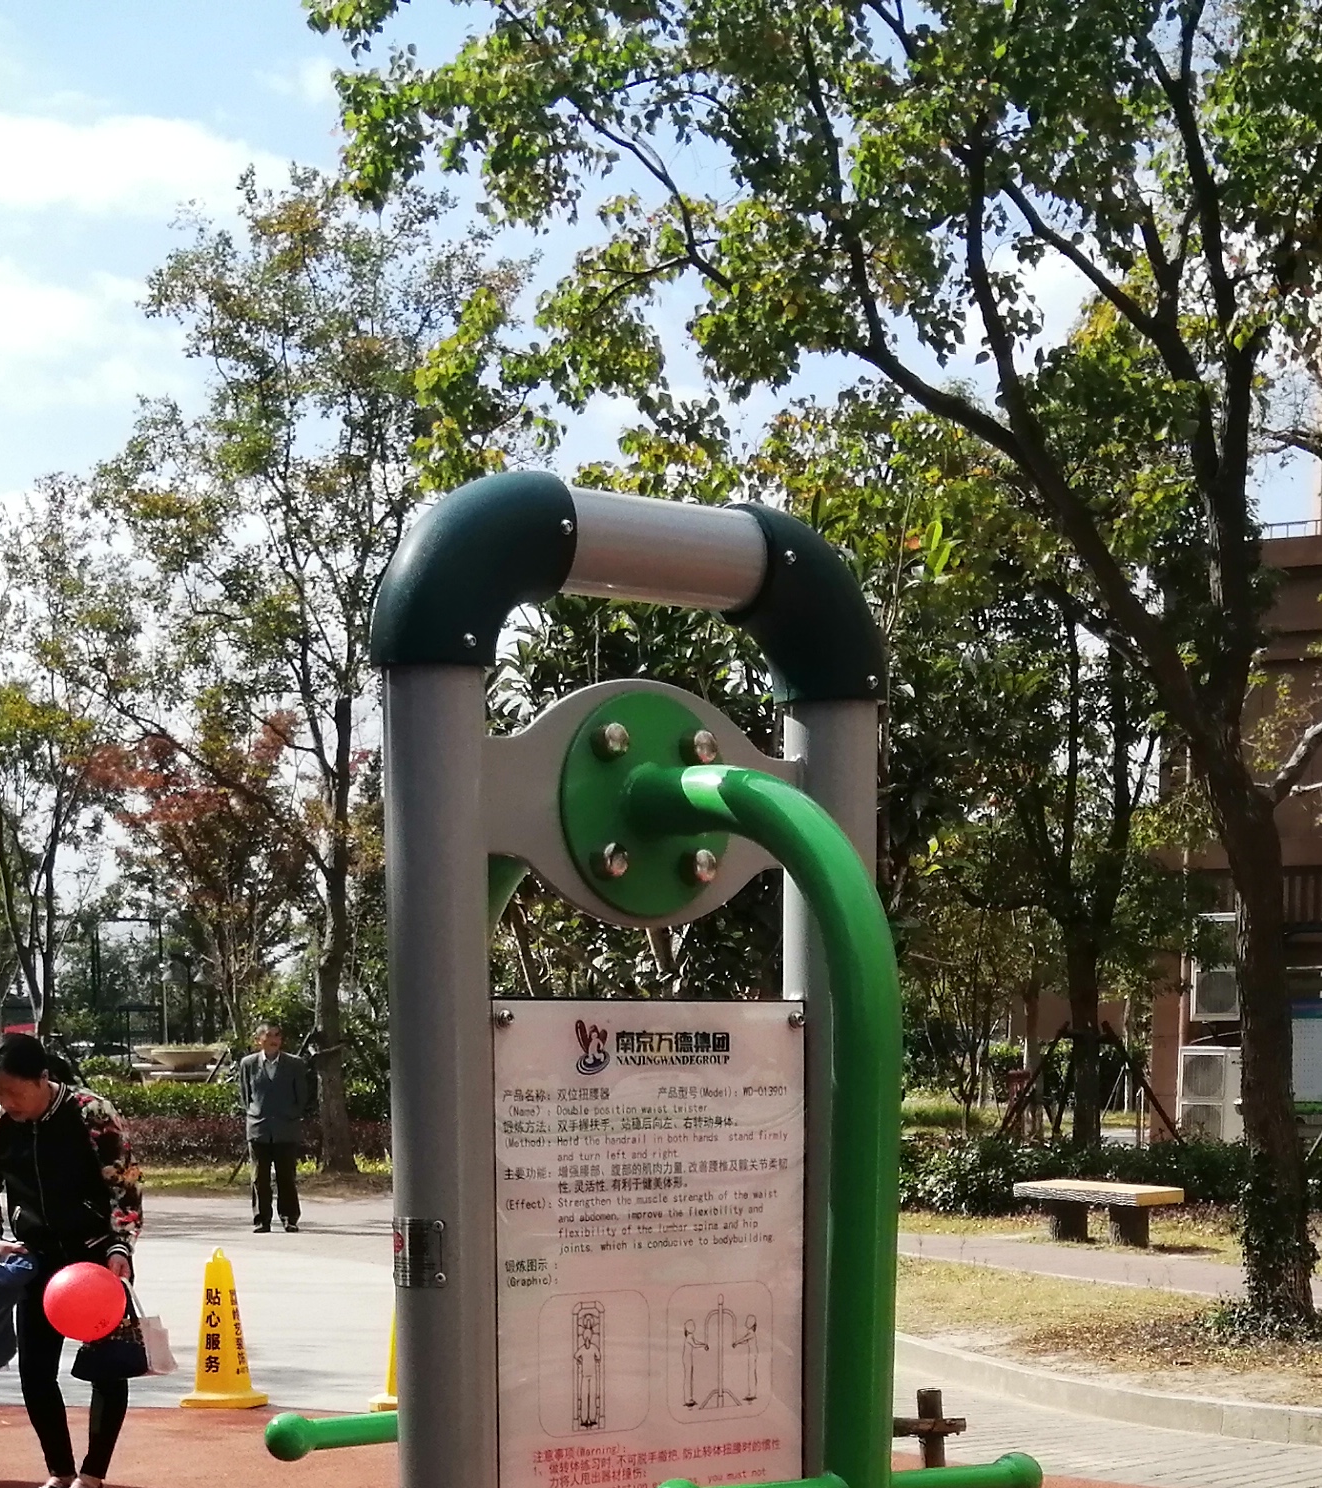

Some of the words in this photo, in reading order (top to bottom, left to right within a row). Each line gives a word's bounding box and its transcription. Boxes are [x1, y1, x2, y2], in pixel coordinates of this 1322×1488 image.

[616, 1030, 730, 1053] 南京万德集团
[616, 1055, 730, 1065] NANJINGWANDEGROUP
[556, 1105, 589, 1115] Double
[594, 1104, 637, 1118] position
[641, 1103, 667, 1114] waist
[673, 1103, 708, 1113] twister
[557, 1136, 579, 1146] Hold
[584, 1135, 600, 1146] the
[605, 1134, 646, 1145] handrail
[653, 1133, 663, 1143] in
[667, 1132, 689, 1143] both
[728, 1131, 754, 1141] stand
[758, 1129, 789, 1144] firmly
[557, 1152, 574, 1162] and
[579, 1152, 600, 1161] turn
[606, 1151, 626, 1160] left
[631, 1149, 648, 1159] and
[505, 1198, 552, 1211] (Effect):
[558, 1196, 611, 1209] Strengthen
[616, 1195, 632, 1205] the
[636, 1194, 668, 1204] muscle
[673, 1191, 714, 1203] strength
[718, 1190, 728, 1201] of
[733, 1190, 749, 1200] the
[753, 1189, 778, 1199] waist
[557, 1213, 574, 1224] and
[627, 1210, 663, 1220] improve
[668, 1208, 683, 1218] the
[688, 1205, 744, 1217] flexibility
[748, 1204, 764, 1214] and
[558, 1226, 617, 1239] flexibility
[621, 1226, 632, 1235] of
[637, 1225, 653, 1235] the
[693, 1221, 719, 1233] spine
[723, 1219, 739, 1230] and
[742, 1218, 759, 1230] hip
[600, 1240, 627, 1251] which
[633, 1240, 643, 1249] is
[647, 1236, 694, 1249] conducive
[698, 1236, 709, 1246] to
[506, 1273, 558, 1288] (Graphic):
[204, 1288, 221, 1374] 贴心服务
[707, 1474, 723, 1483] you
[727, 1470, 747, 1480] must
[751, 1467, 766, 1477] not
